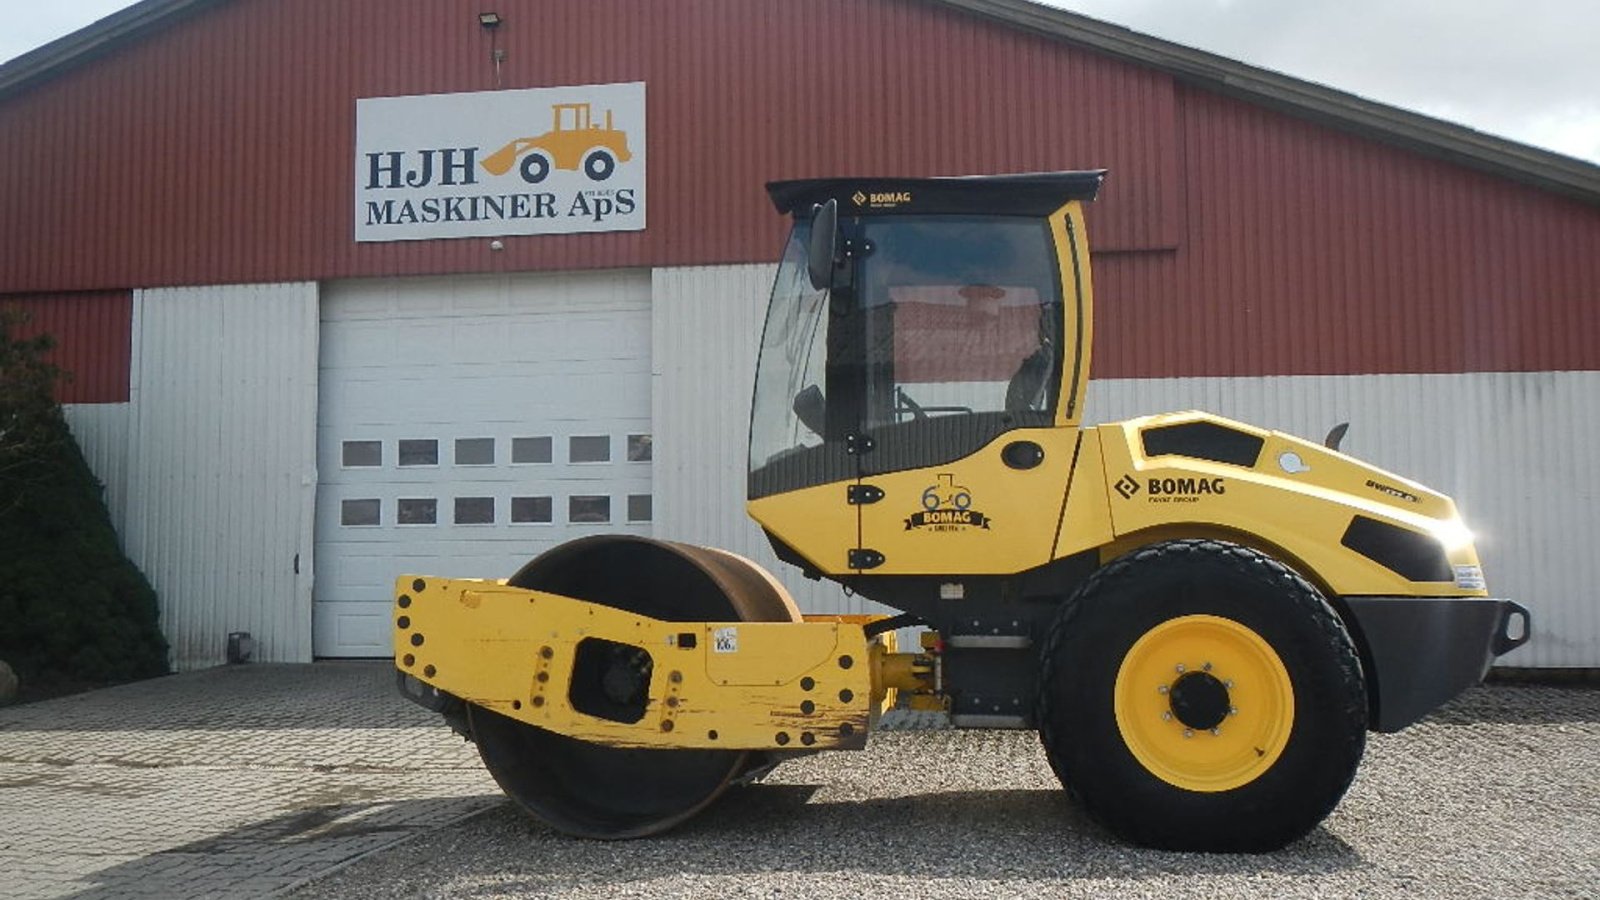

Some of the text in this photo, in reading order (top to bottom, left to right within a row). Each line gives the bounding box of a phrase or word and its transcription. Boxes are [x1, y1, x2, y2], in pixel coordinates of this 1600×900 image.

[365, 147, 479, 190] HJH
[869, 192, 911, 203] BOMAG
[365, 188, 635, 225] MASKINER ApS
[1148, 478, 1225, 494] BOMAG
[923, 511, 971, 523] BOMAG
